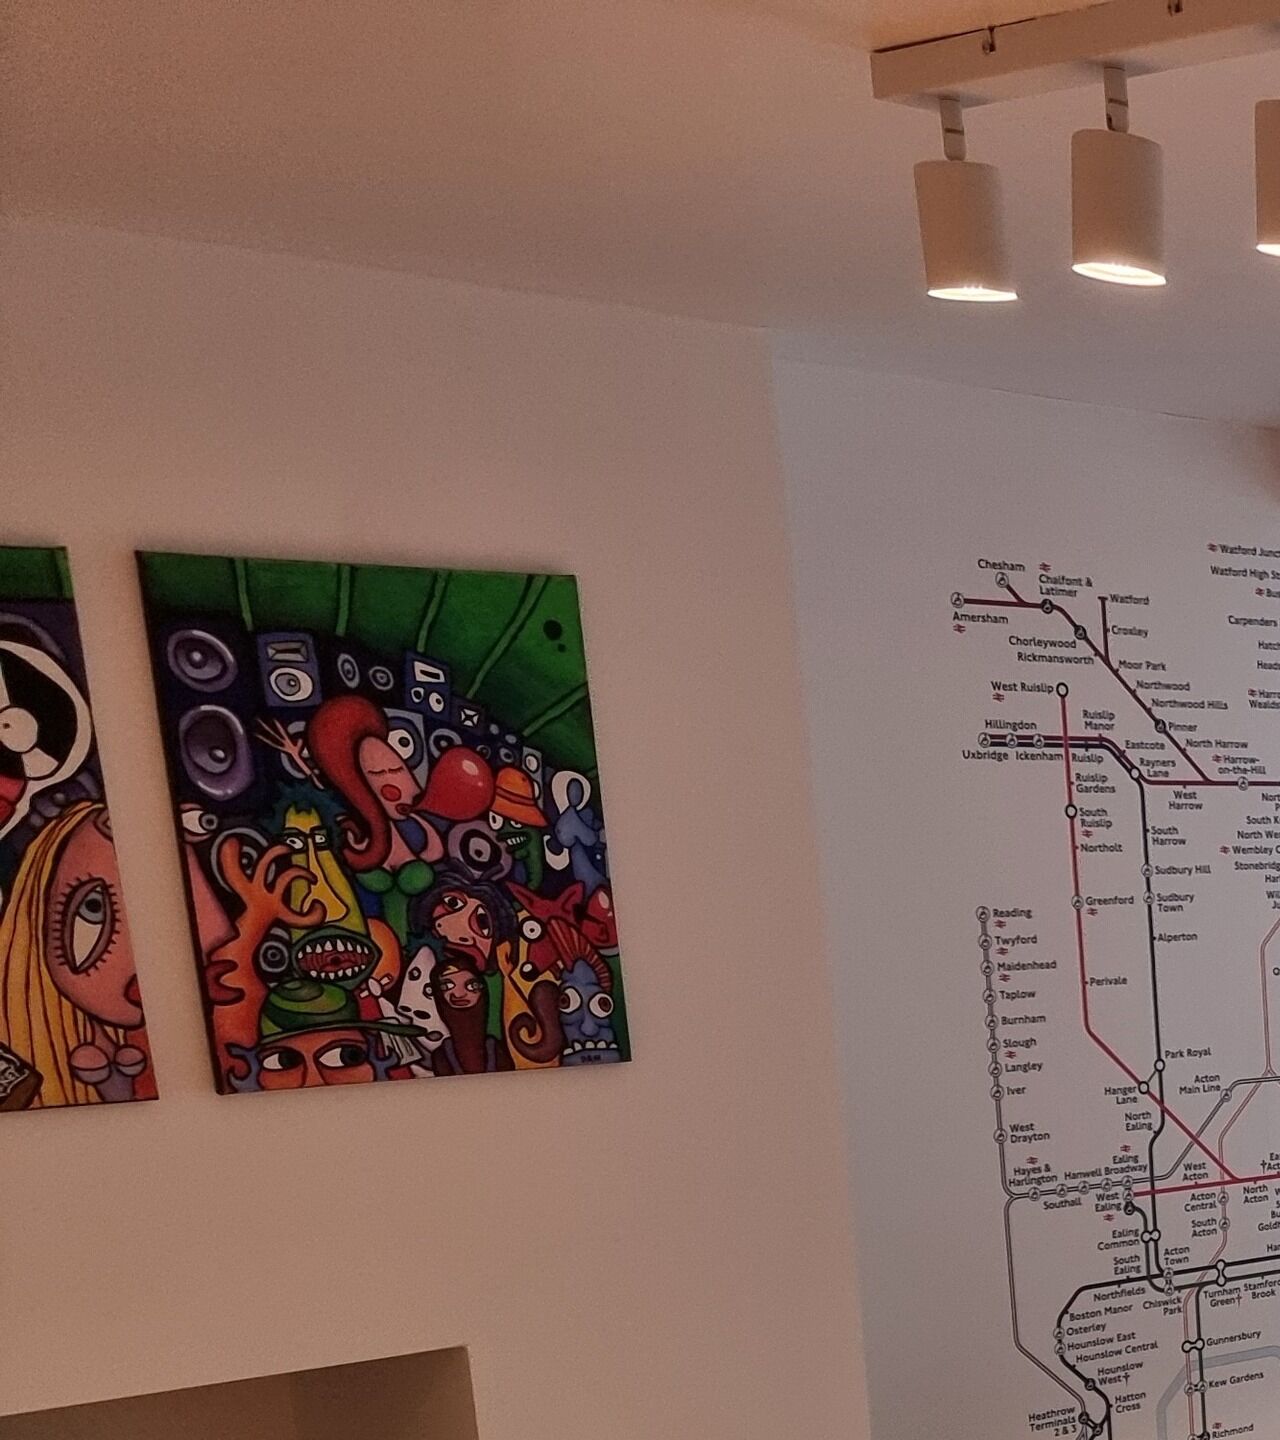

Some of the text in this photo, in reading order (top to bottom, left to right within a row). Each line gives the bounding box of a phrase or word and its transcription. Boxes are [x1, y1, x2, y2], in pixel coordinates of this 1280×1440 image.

[1219, 545, 1257, 556] Watford
[978, 559, 1025, 572] Chesham
[1211, 567, 1247, 577] Watford
[1250, 569, 1269, 580] High
[1039, 574, 1082, 588] Chalfont
[1040, 586, 1077, 597] Latimer
[1110, 594, 1149, 605] Watford
[953, 613, 1008, 626] Amersham
[1228, 616, 1277, 628] Carpenders
[1009, 635, 1078, 649] Chorleywood
[1018, 651, 1096, 664] Rickmansworth
[1118, 660, 1166, 671] Moor Park
[991, 682, 1054, 694] West Ruislip
[1135, 681, 1190, 694] Northwood
[1150, 699, 1228, 710] Northwood Hills
[983, 720, 1037, 731] Hillingdon
[1167, 722, 1197, 734] Pinner
[1123, 740, 1165, 751] Eastcote
[1185, 739, 1248, 750] North Harrow
[962, 750, 1008, 762] Uxbridge
[1016, 751, 1065, 761] Ickenham
[1072, 751, 1103, 764] Ruislip
[1223, 756, 1261, 767] Harrow-
[1218, 764, 1266, 777] on-the-Hill
[1079, 808, 1107, 817] South
[1080, 818, 1112, 830] Ruislip
[1081, 843, 1122, 853] Northolt
[1155, 866, 1192, 875] Sudbury
[1086, 896, 1134, 905] Greenford
[993, 908, 1032, 918] Reading
[995, 935, 1037, 946] Twyford
[1158, 933, 1197, 942] Alperton
[997, 961, 1057, 971] Maidenhead
[1090, 977, 1127, 986] Perivale
[1000, 990, 1036, 1000] Taplow
[1002, 1015, 1046, 1025] Burnham
[1003, 1038, 1036, 1048] Slough
[1165, 1050, 1184, 1058] Park
[1005, 1063, 1042, 1073] Langley
[1105, 1087, 1138, 1095] Hanger
[1115, 1095, 1137, 1104] Lane
[1009, 1124, 1035, 1132] West
[1011, 1131, 1050, 1143] Drayton
[1044, 1197, 1082, 1209] Southall
[1092, 1286, 1147, 1303] Northfields
[1068, 1305, 1132, 1321] Boston Manor
[1066, 1324, 1106, 1336] Osterley
[1067, 1332, 1135, 1351] Hounslow East
[1206, 1332, 1261, 1346] Gunnersbury
[1074, 1340, 1158, 1362] Hounslow Central
[1209, 1373, 1264, 1388] Kew Gardens
[1115, 1392, 1146, 1403] Hatton
[1115, 1401, 1141, 1413] Cross
[1029, 1408, 1076, 1423] Heathrow
[1029, 1416, 1076, 1433] Terminals
[1212, 1424, 1254, 1440] Richmond
